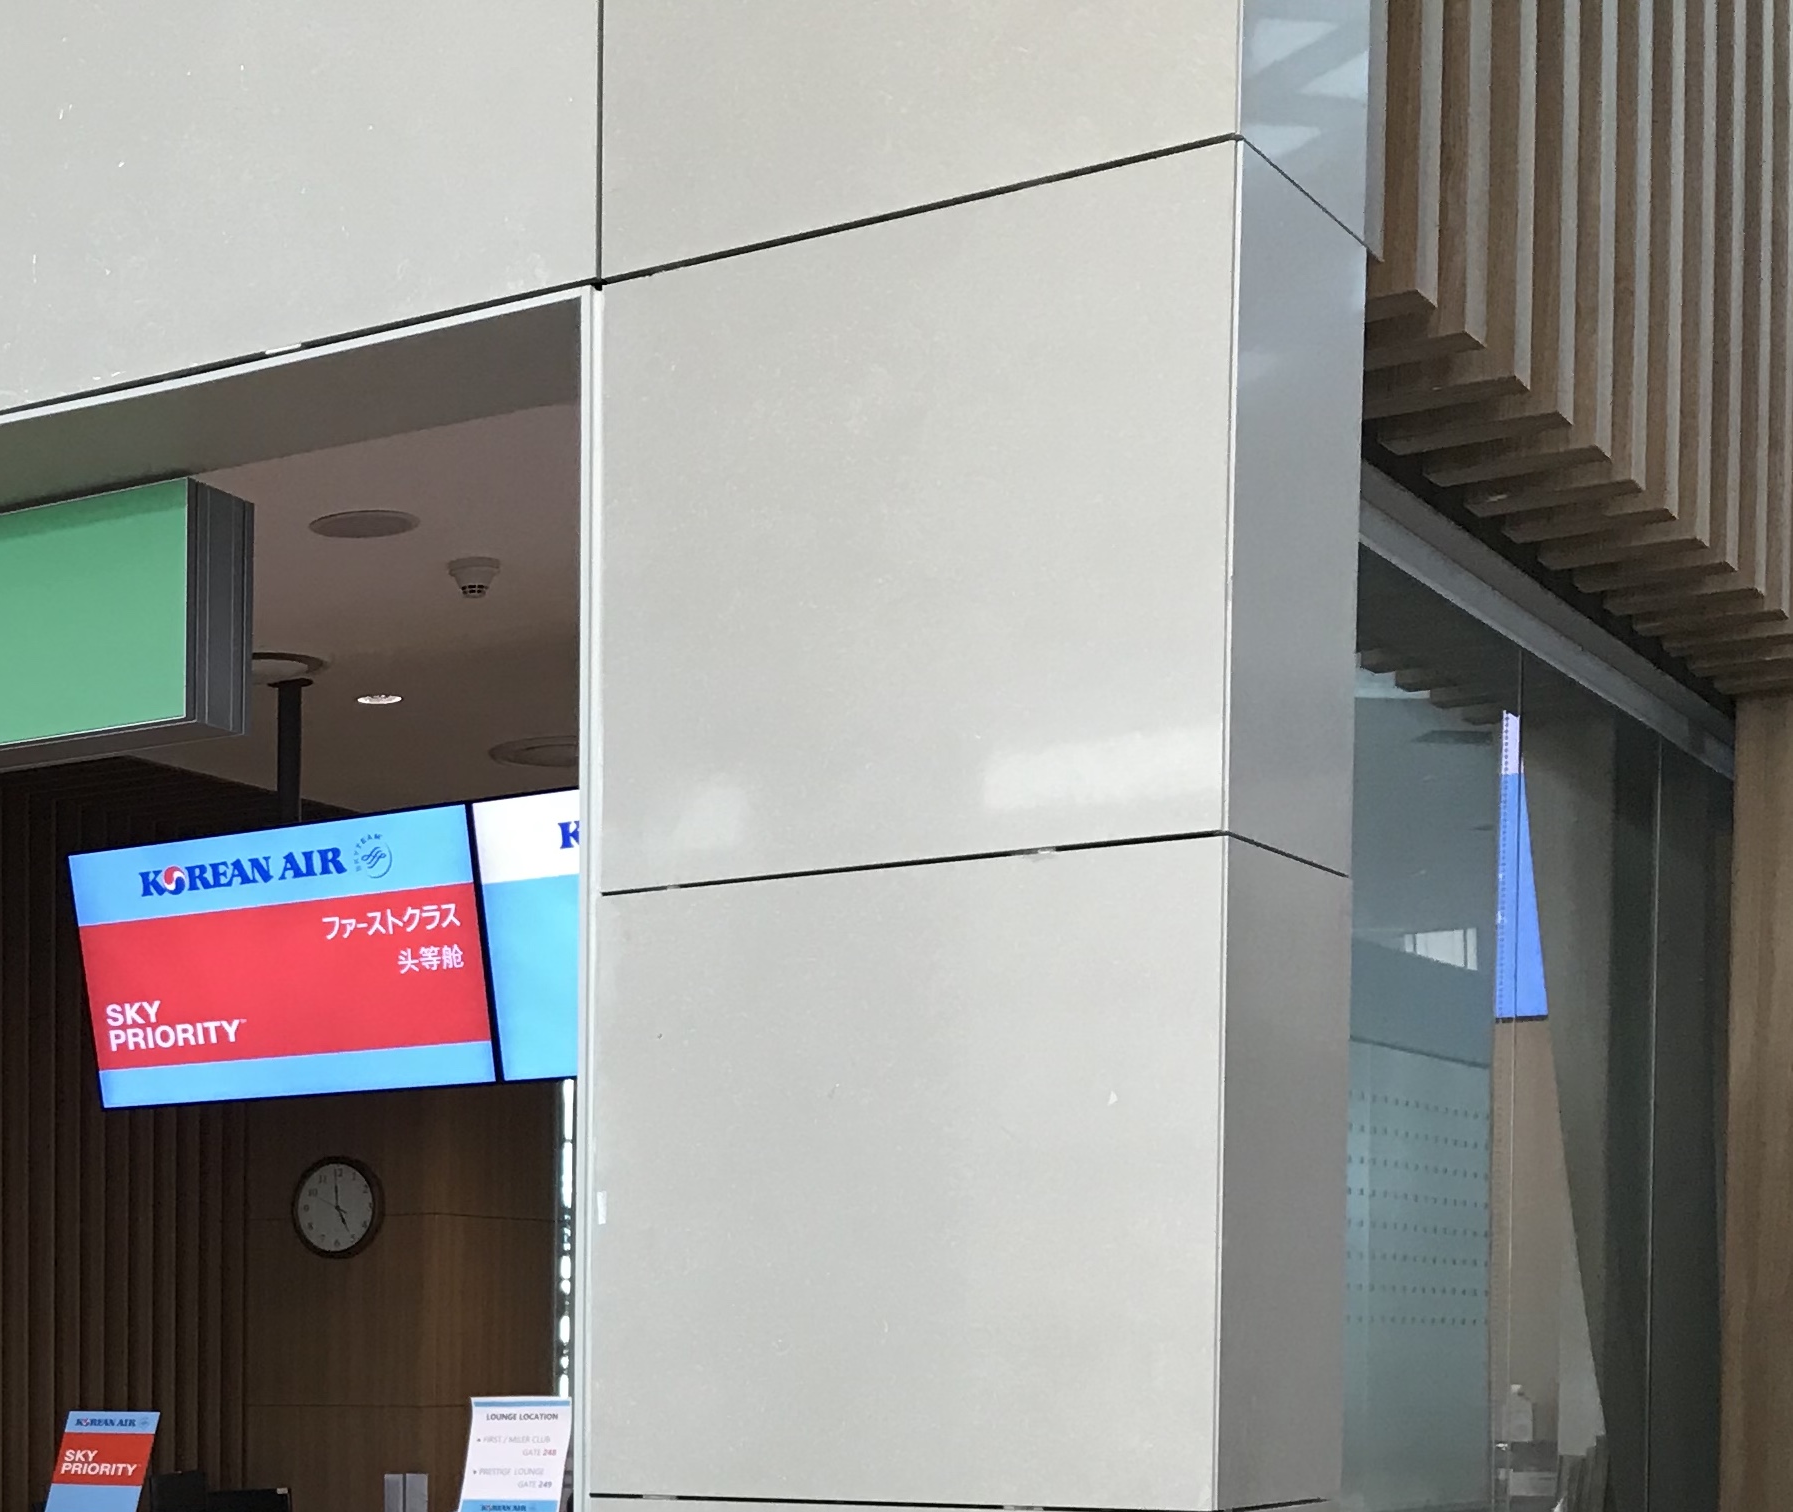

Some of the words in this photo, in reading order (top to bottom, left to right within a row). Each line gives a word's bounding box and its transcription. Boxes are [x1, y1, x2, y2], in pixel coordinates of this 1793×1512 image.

[139, 856, 273, 897] KOREAN
[278, 847, 347, 880] AIR
[322, 903, 461, 940] ファーストクラス
[397, 944, 464, 974] 头等舱
[106, 1000, 161, 1027] SKY
[109, 1020, 241, 1051] PRIORITY
[116, 1418, 137, 1427] AIR
[486, 1413, 517, 1421] LOUNGE
[60, 1462, 138, 1476] PRIORITY
[64, 1449, 98, 1462] SKY
